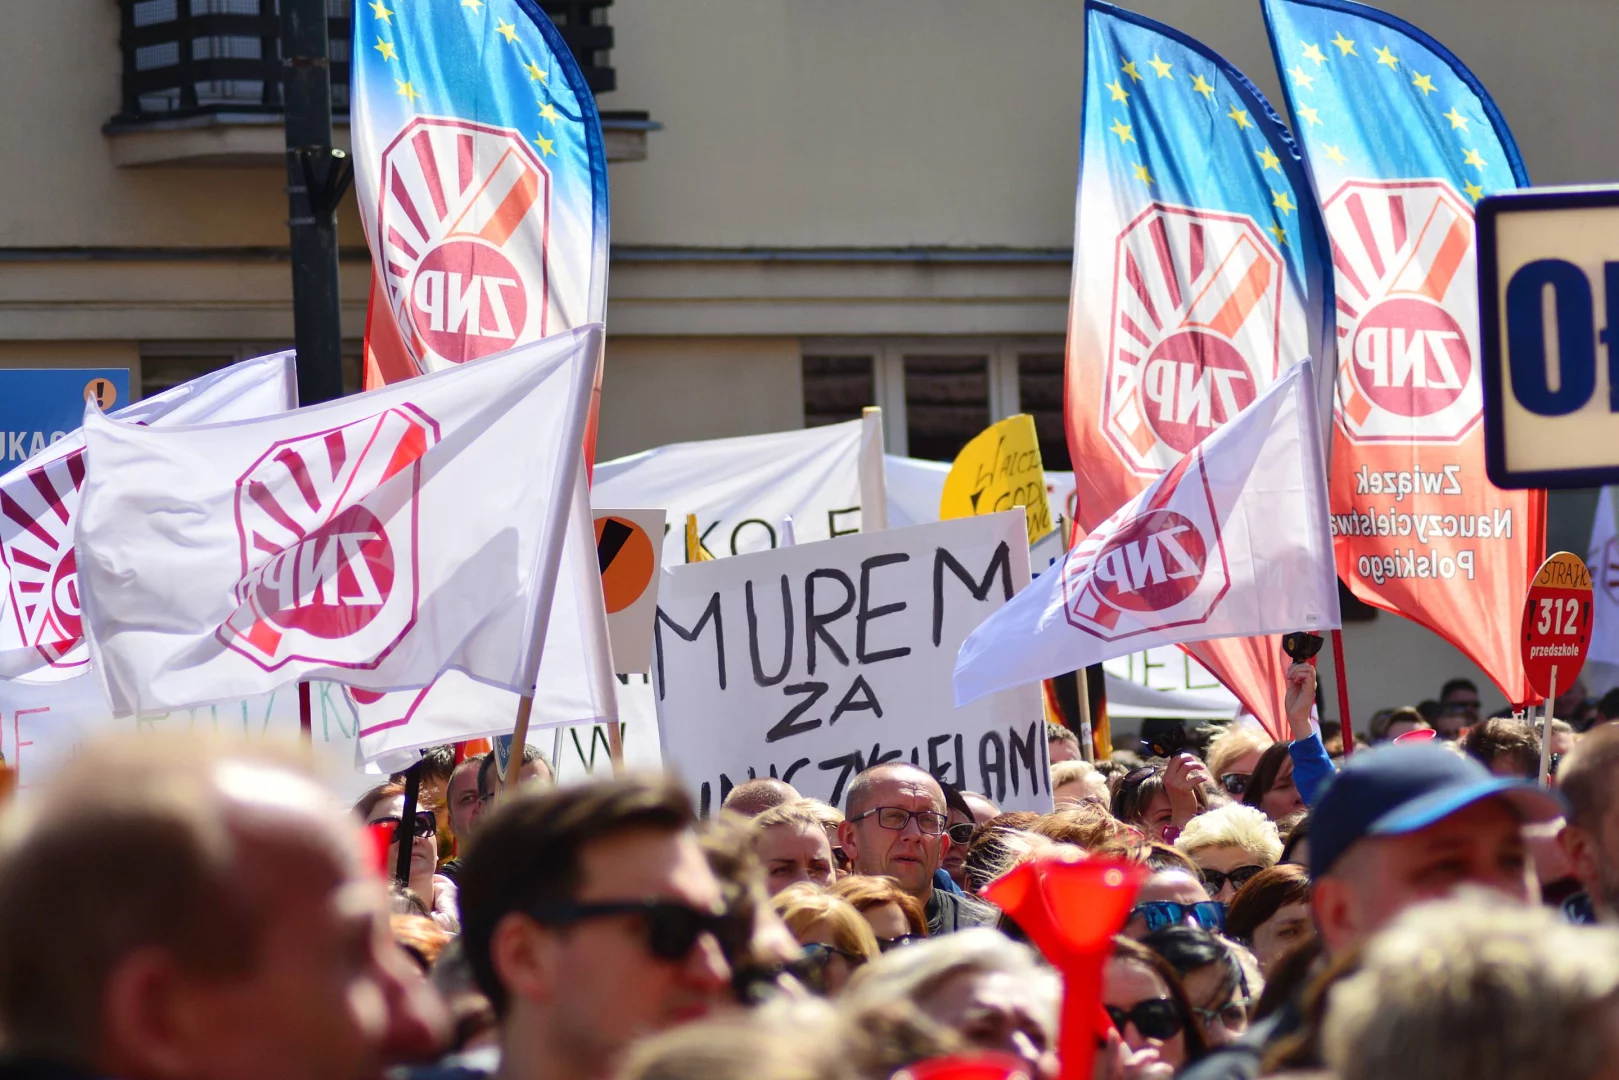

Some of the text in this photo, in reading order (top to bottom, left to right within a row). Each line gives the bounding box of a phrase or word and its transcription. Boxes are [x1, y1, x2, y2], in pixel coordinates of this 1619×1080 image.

[1540, 560, 1588, 588] STRAJK
[654, 540, 1015, 702] MUREM
[1537, 597, 1580, 636] 312
[1530, 642, 1580, 660] przedszkole
[765, 674, 884, 744] ZA
